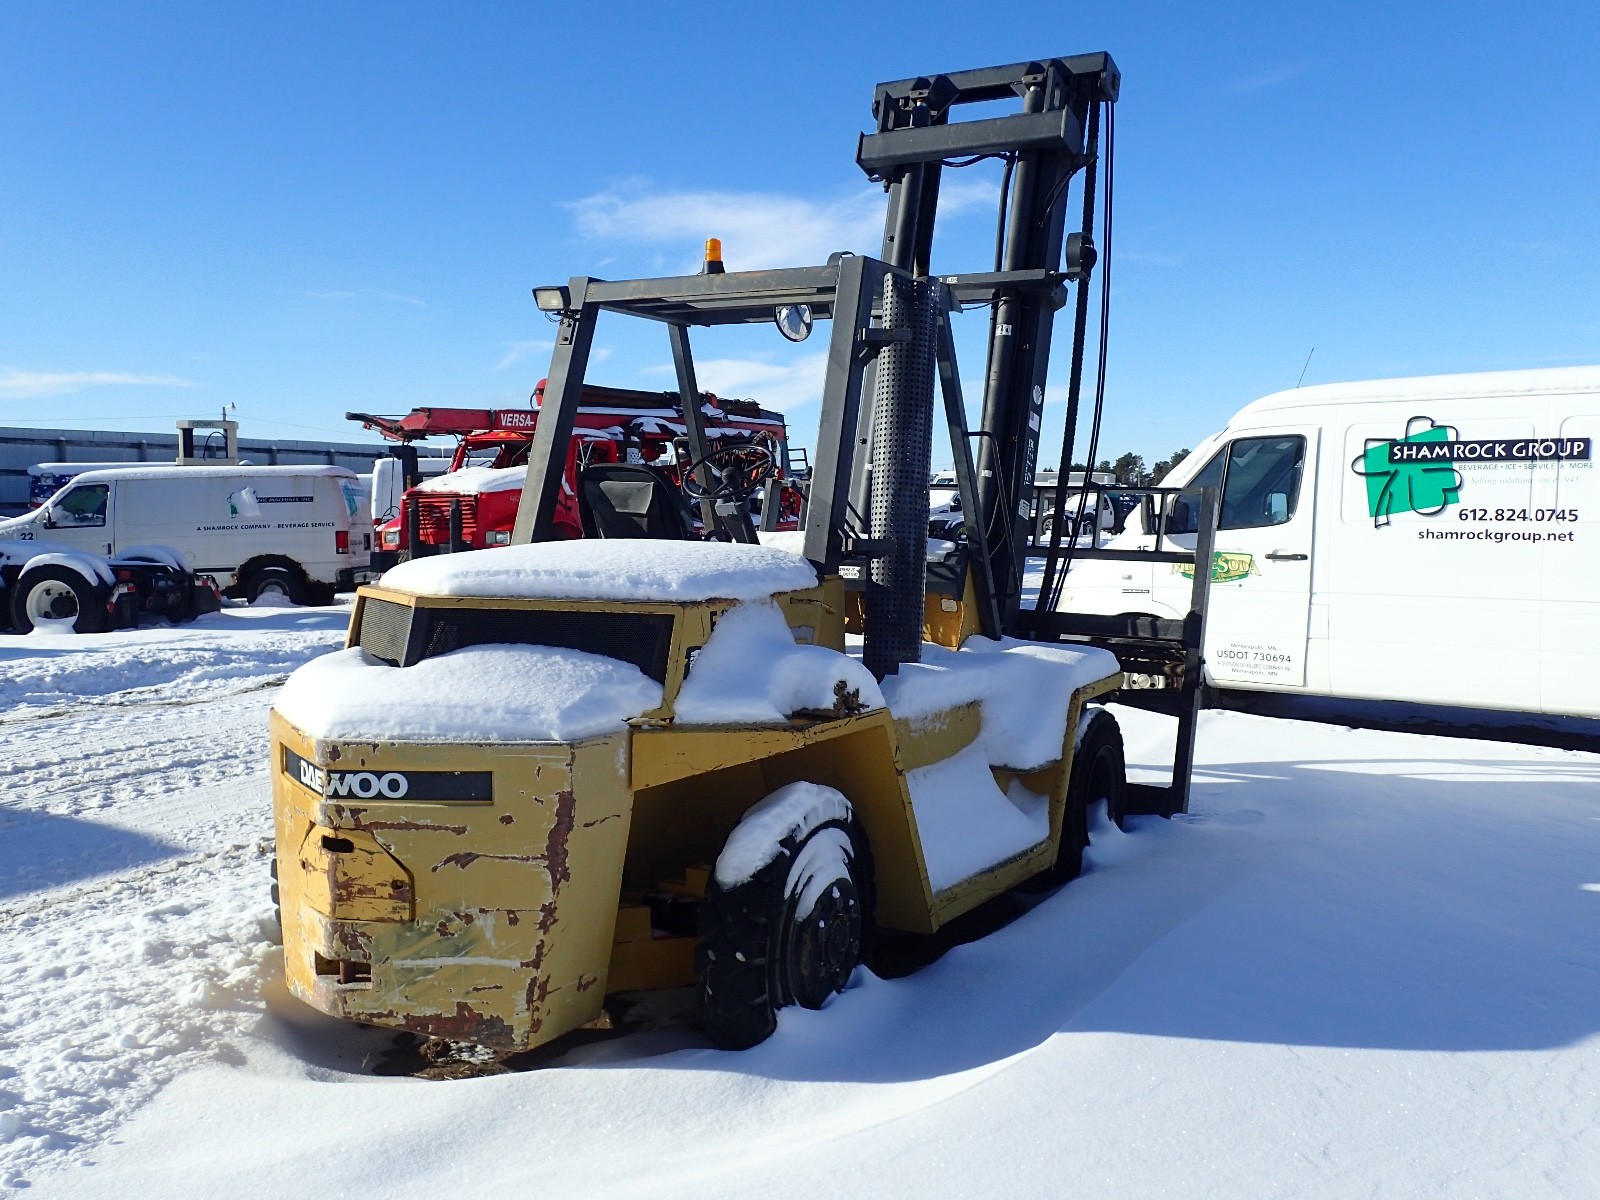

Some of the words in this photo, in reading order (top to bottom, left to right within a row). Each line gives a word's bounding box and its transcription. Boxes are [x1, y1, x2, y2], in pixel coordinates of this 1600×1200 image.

[1393, 443, 1506, 460] SHAMROCK
[1512, 441, 1585, 457] GROUP
[1459, 463, 1498, 471] BEVERAGE
[1458, 508, 1579, 522] 612.824.0745
[20, 532, 34, 540] 22
[1418, 529, 1574, 543] shamrockgroup.net
[1216, 650, 1249, 660] USDOT
[1253, 652, 1291, 663] 730694
[300, 759, 409, 798] DAEWOO
